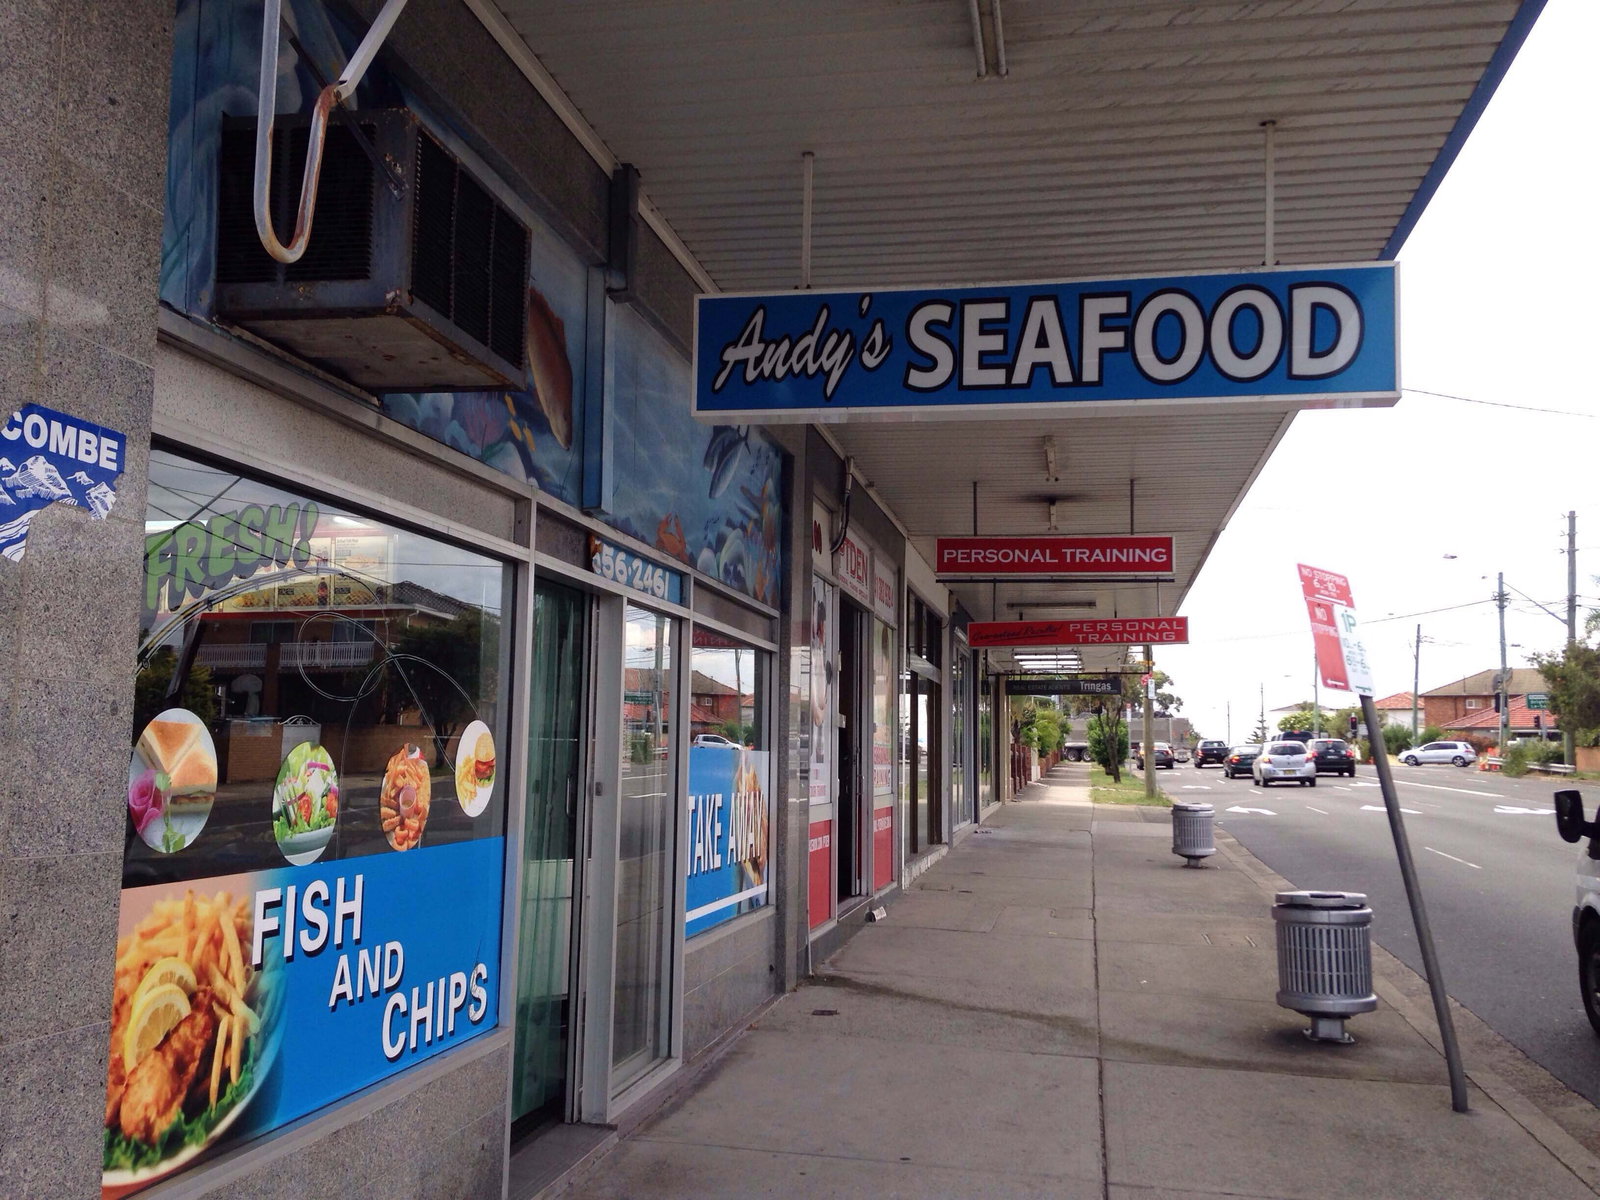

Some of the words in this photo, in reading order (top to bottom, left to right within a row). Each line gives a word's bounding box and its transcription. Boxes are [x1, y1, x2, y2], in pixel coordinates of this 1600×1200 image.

[712, 296, 891, 398] Andy's
[906, 285, 1363, 391] SEAFOOD
[143, 502, 319, 612] FRESH!
[942, 548, 1059, 564] PERSONAL
[1062, 547, 1168, 564] TRAINING
[1069, 620, 1184, 632] PERSONAL
[1075, 631, 1176, 643] TRAINING
[1079, 680, 1112, 692] Tringas
[687, 793, 723, 876] TAKE
[727, 790, 763, 865] AWAY
[252, 874, 364, 968] FISH
[329, 941, 405, 1009] AND
[382, 963, 488, 1060] CHIPS
